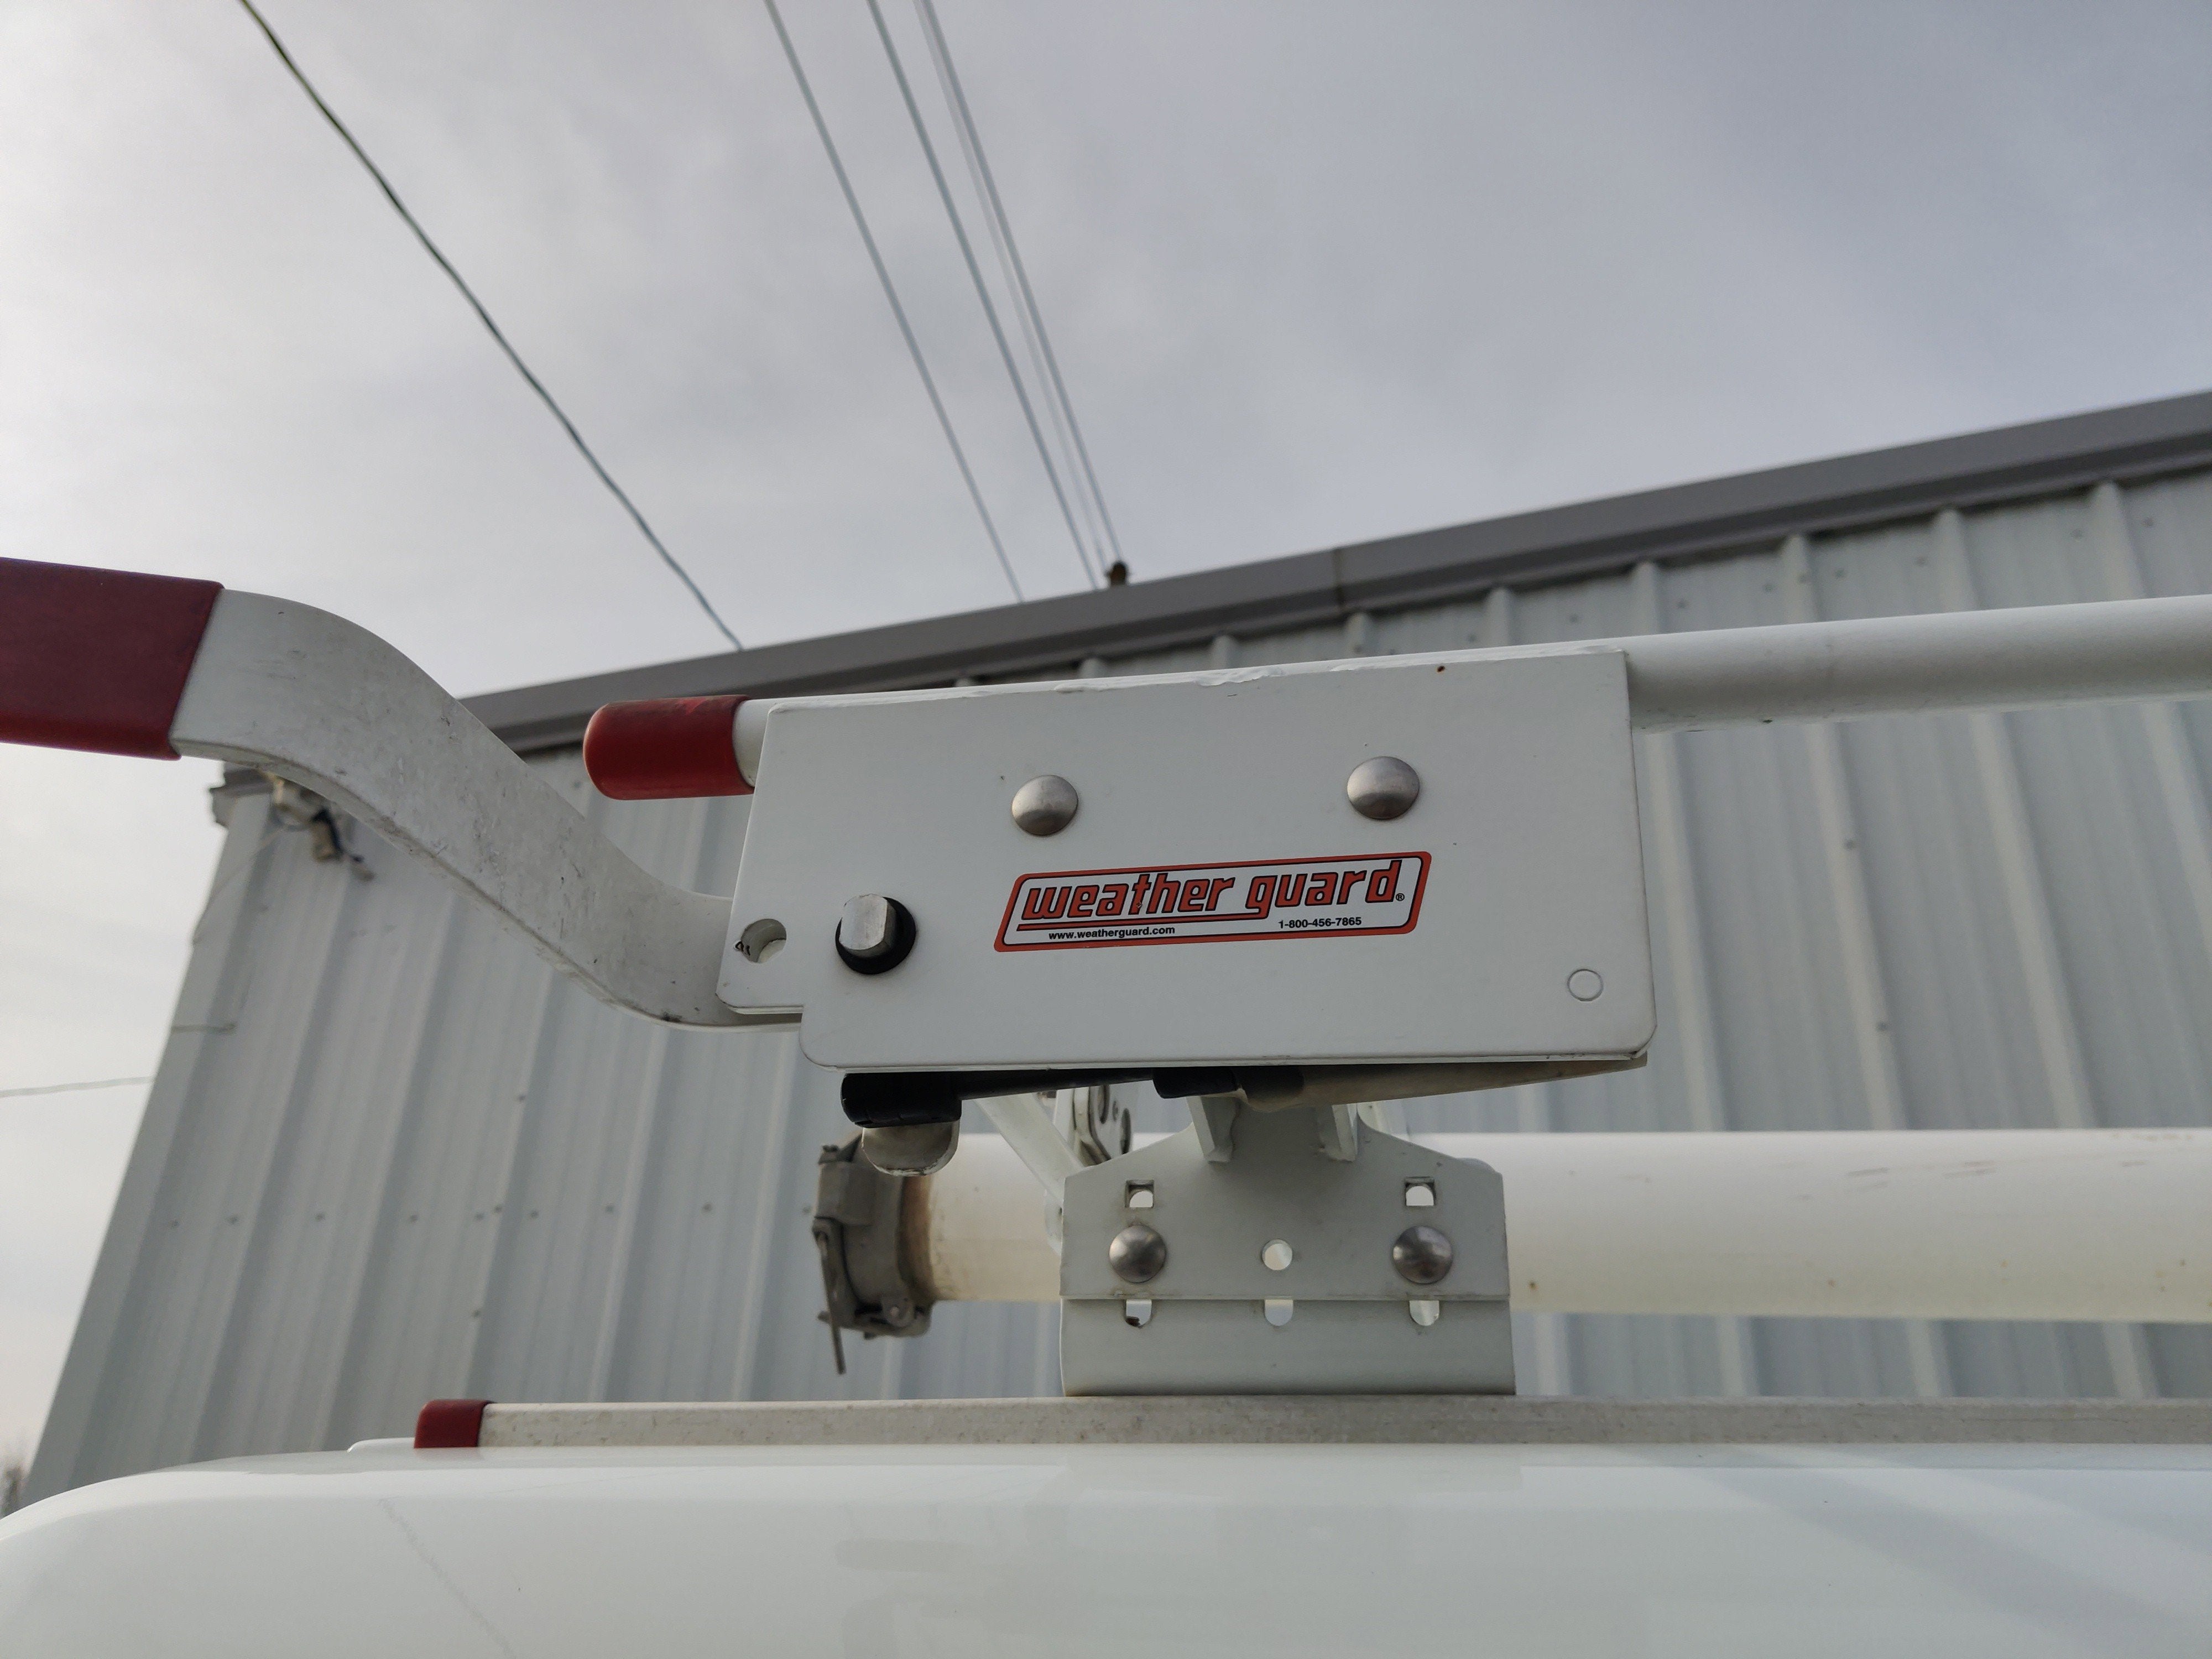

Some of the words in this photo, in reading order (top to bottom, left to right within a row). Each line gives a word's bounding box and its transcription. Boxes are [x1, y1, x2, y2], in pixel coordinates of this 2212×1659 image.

[1022, 873, 1235, 920] weather
[1279, 917, 1362, 929] 1-800-456-7865
[1048, 926, 1175, 939] www.weatherguard.com
